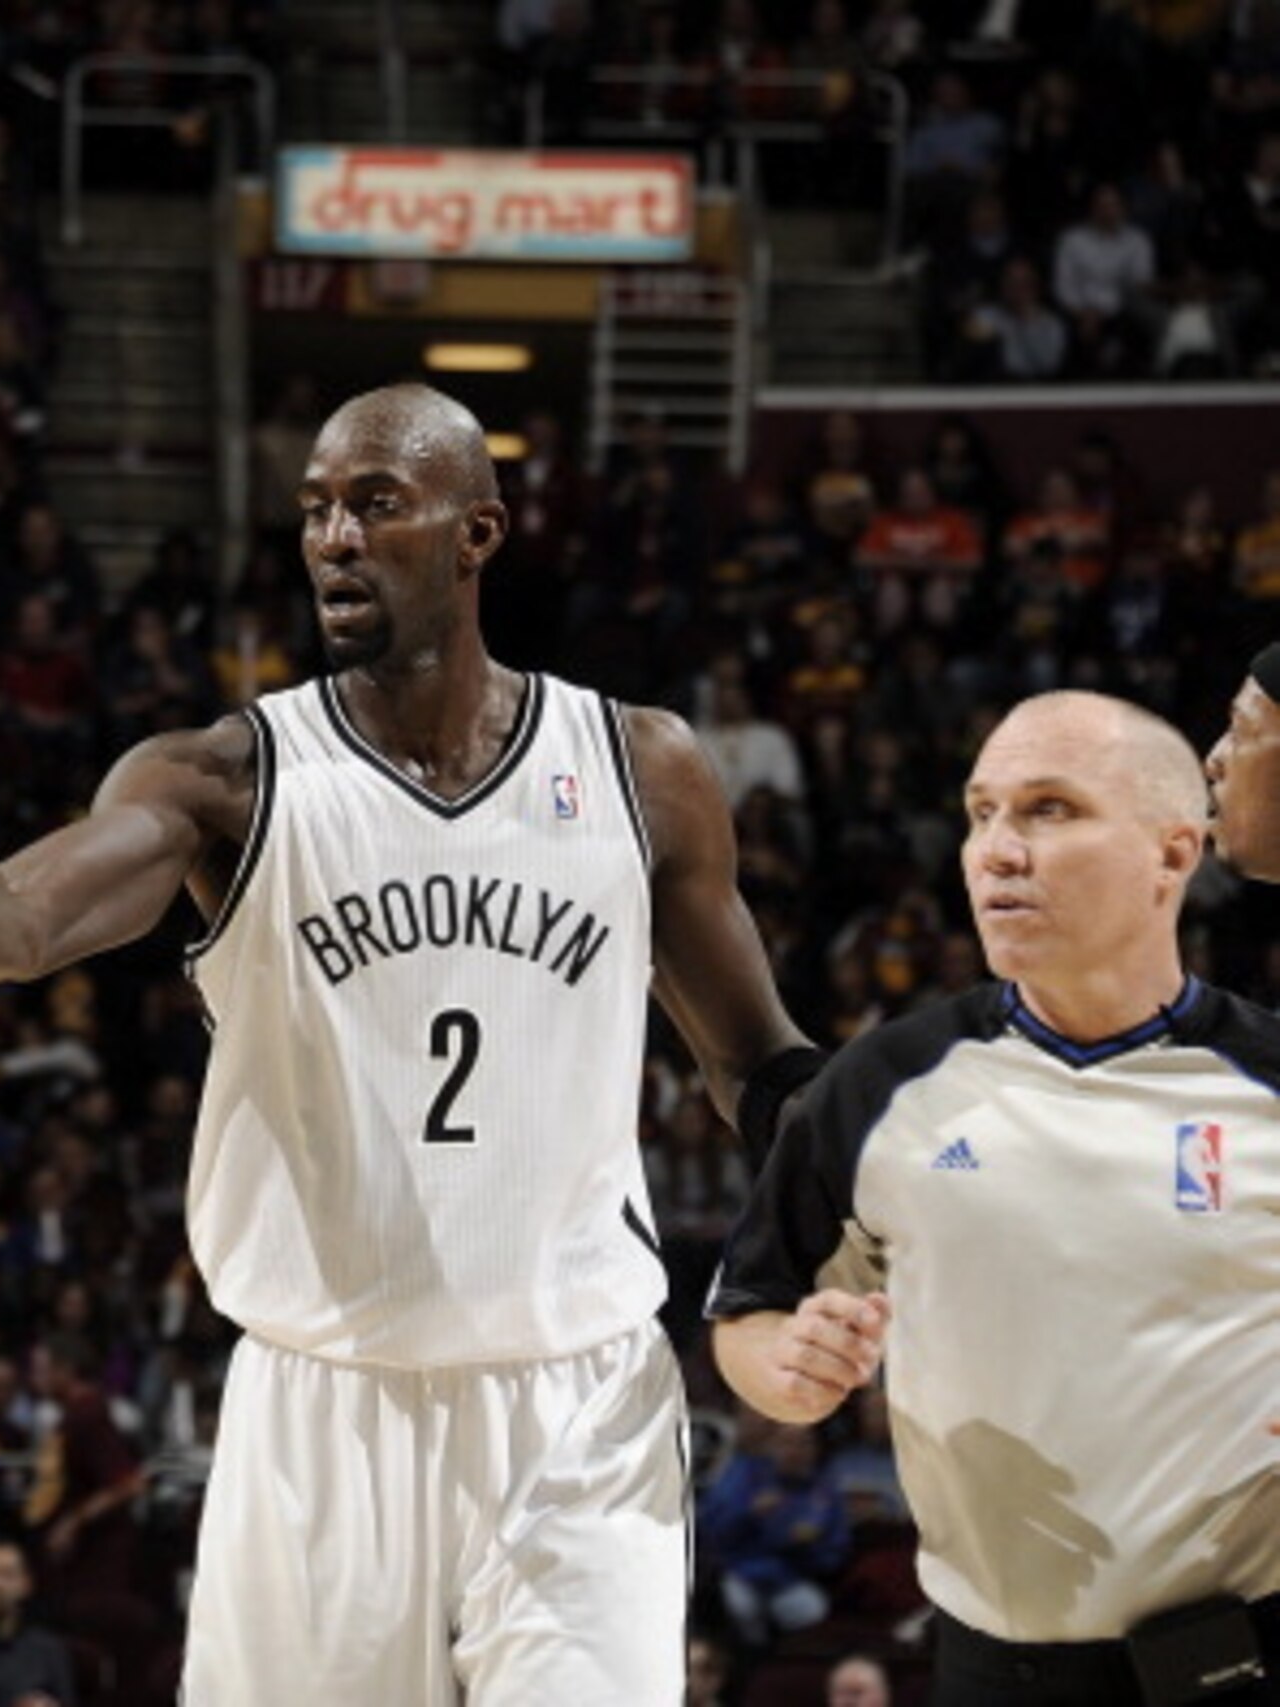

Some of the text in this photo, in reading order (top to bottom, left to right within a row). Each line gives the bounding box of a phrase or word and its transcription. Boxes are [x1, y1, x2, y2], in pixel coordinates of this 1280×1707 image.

[311, 162, 688, 254] drug mart
[297, 874, 611, 988] BROOKLYN
[422, 1008, 481, 1143] 2
